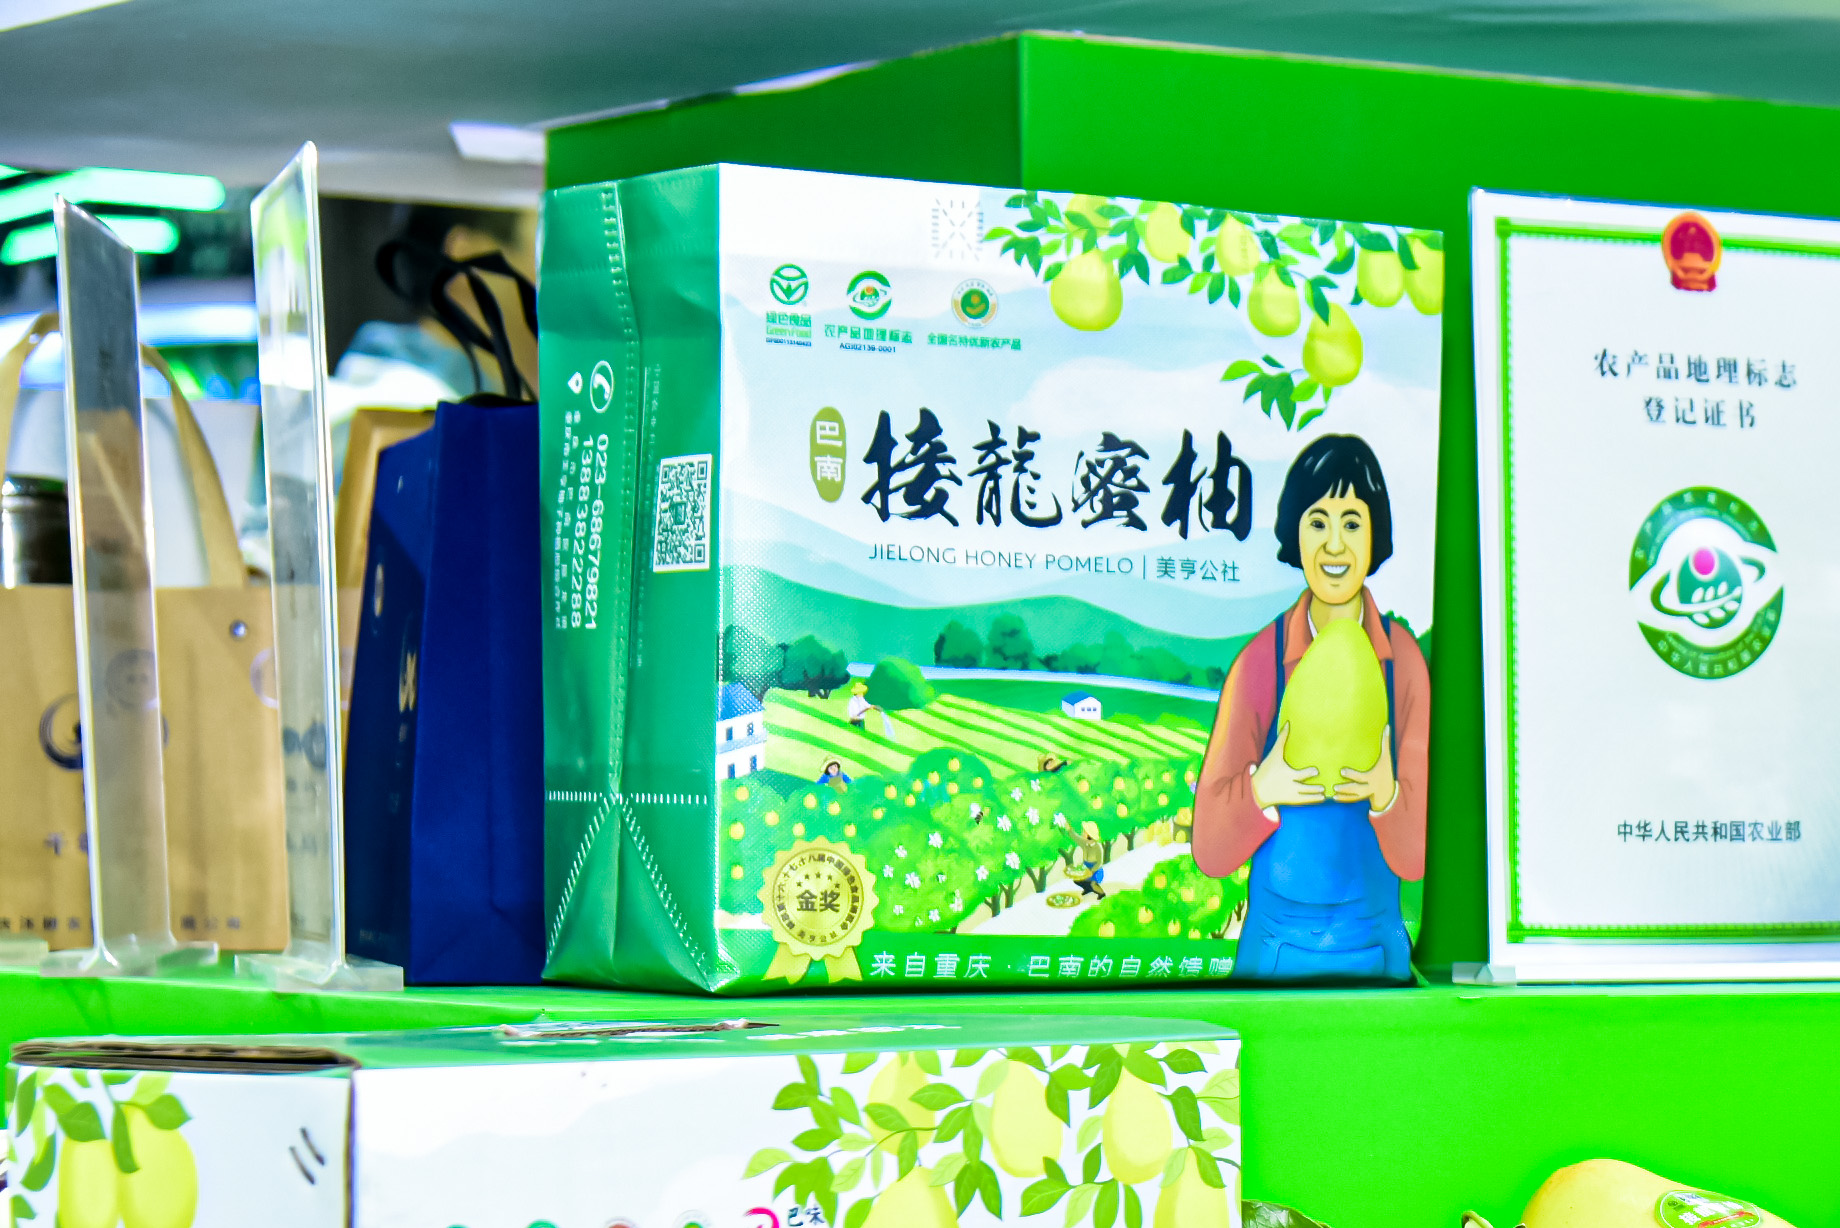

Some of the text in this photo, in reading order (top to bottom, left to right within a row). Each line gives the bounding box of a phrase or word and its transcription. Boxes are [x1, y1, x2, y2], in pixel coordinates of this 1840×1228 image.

[1593, 348, 1798, 390] 农产品地理标志
[1643, 395, 1757, 429] 登记证书
[815, 419, 844, 484] 巴南
[571, 435, 595, 629] 13883822288
[584, 433, 609, 630] 023-68679821
[869, 542, 1134, 575] JIELONG HONEY POMELO
[1156, 554, 1241, 583] 美亨公社
[1616, 819, 1802, 846] 中华人民共和国农业部
[796, 889, 841, 913] 金奖
